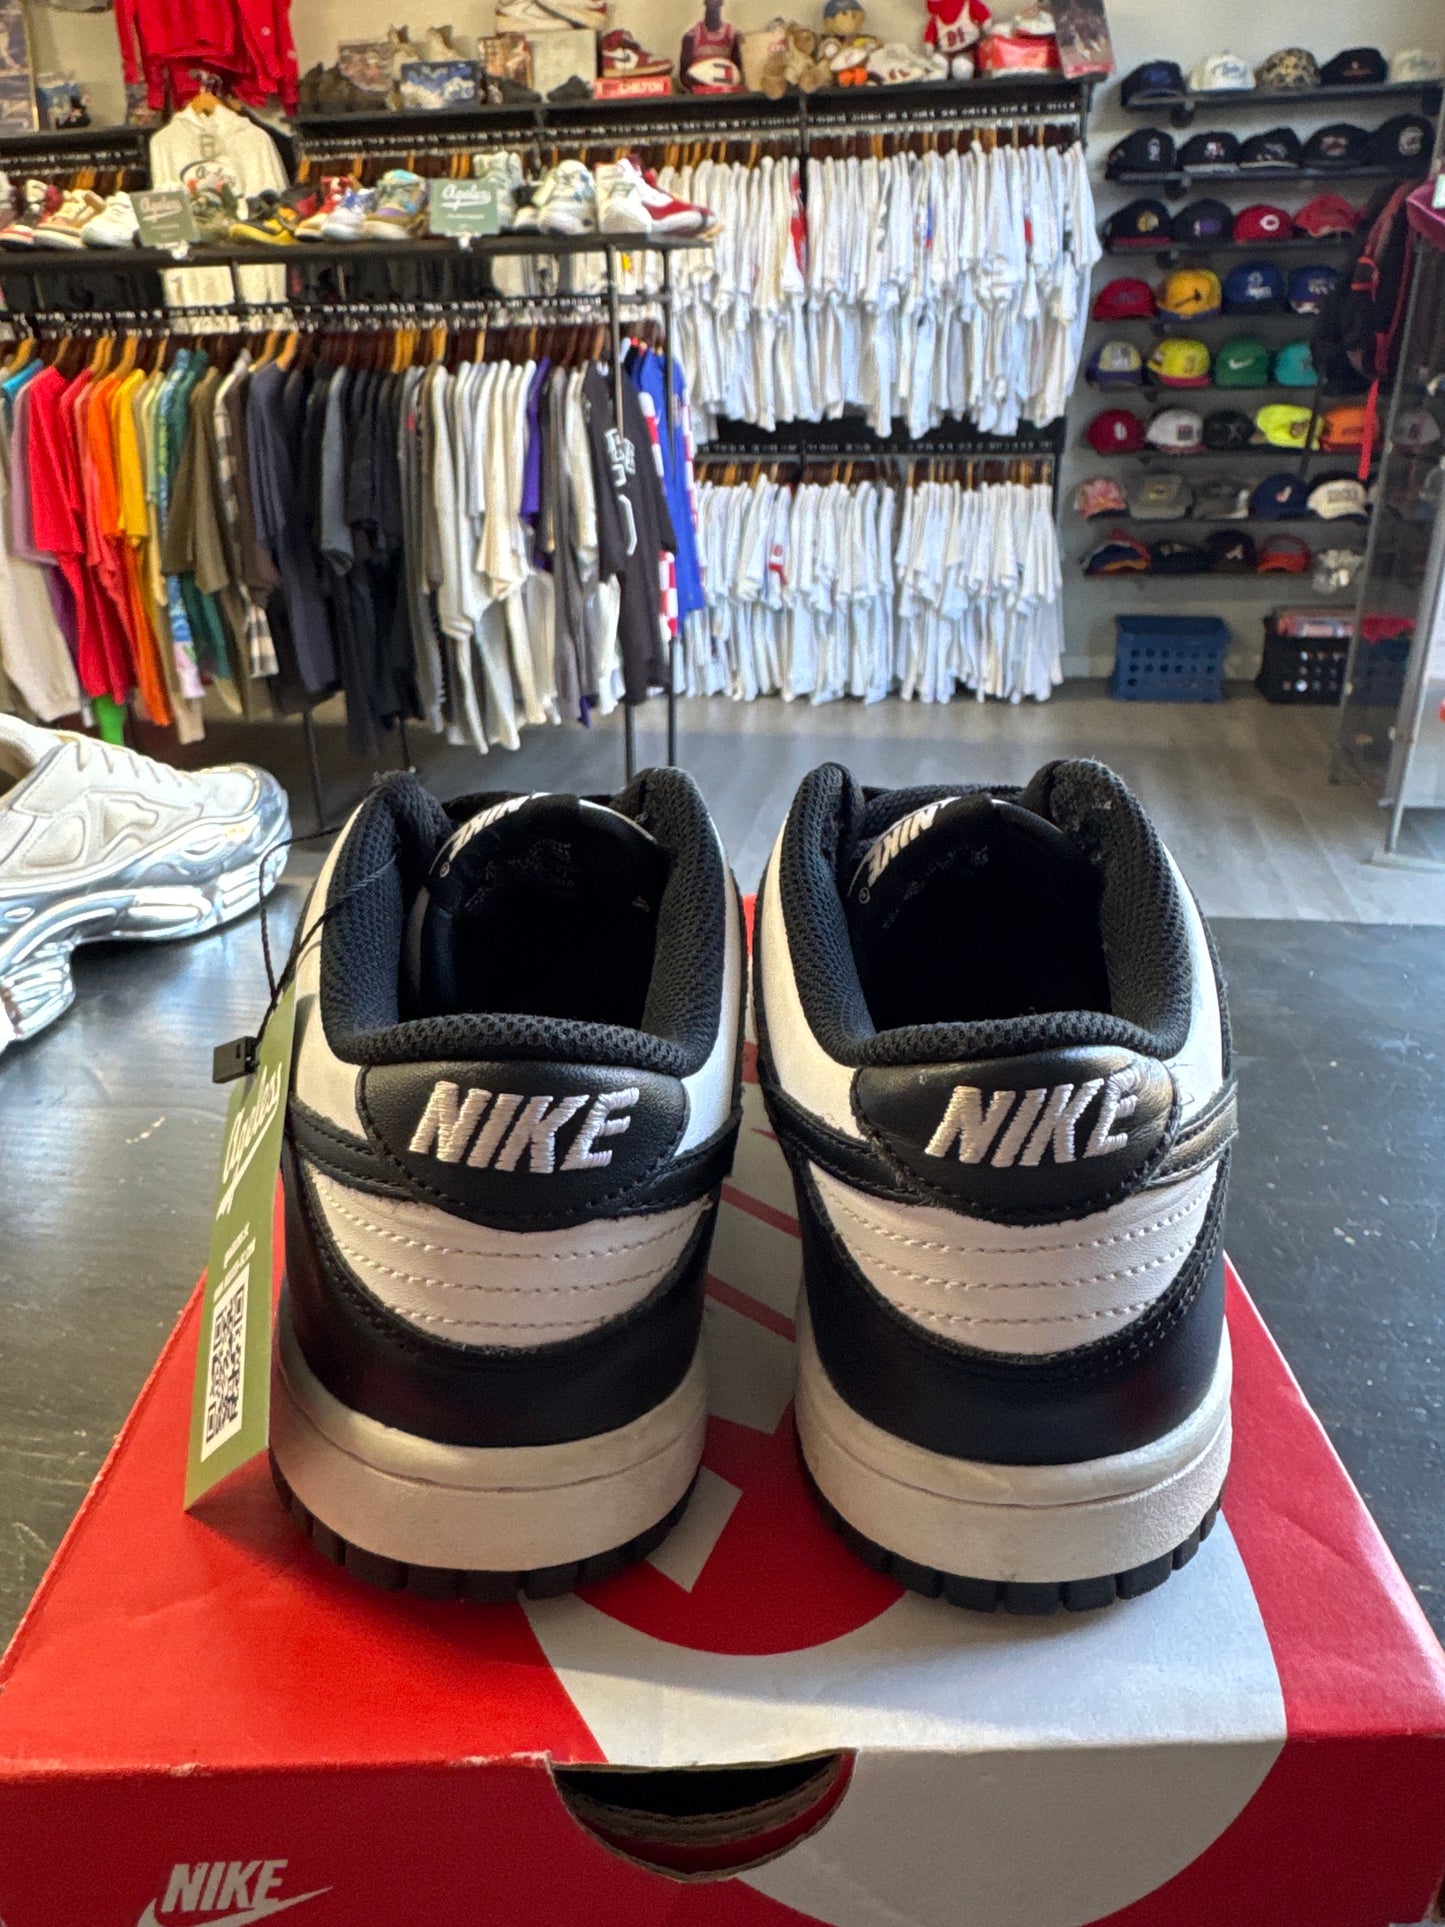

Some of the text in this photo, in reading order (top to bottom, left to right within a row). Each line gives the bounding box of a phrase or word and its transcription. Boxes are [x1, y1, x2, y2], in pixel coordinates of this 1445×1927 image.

[409, 1080, 640, 1174] NIKE
[925, 1066, 1140, 1168] NIKE
[161, 1859, 289, 1914] NIKE
